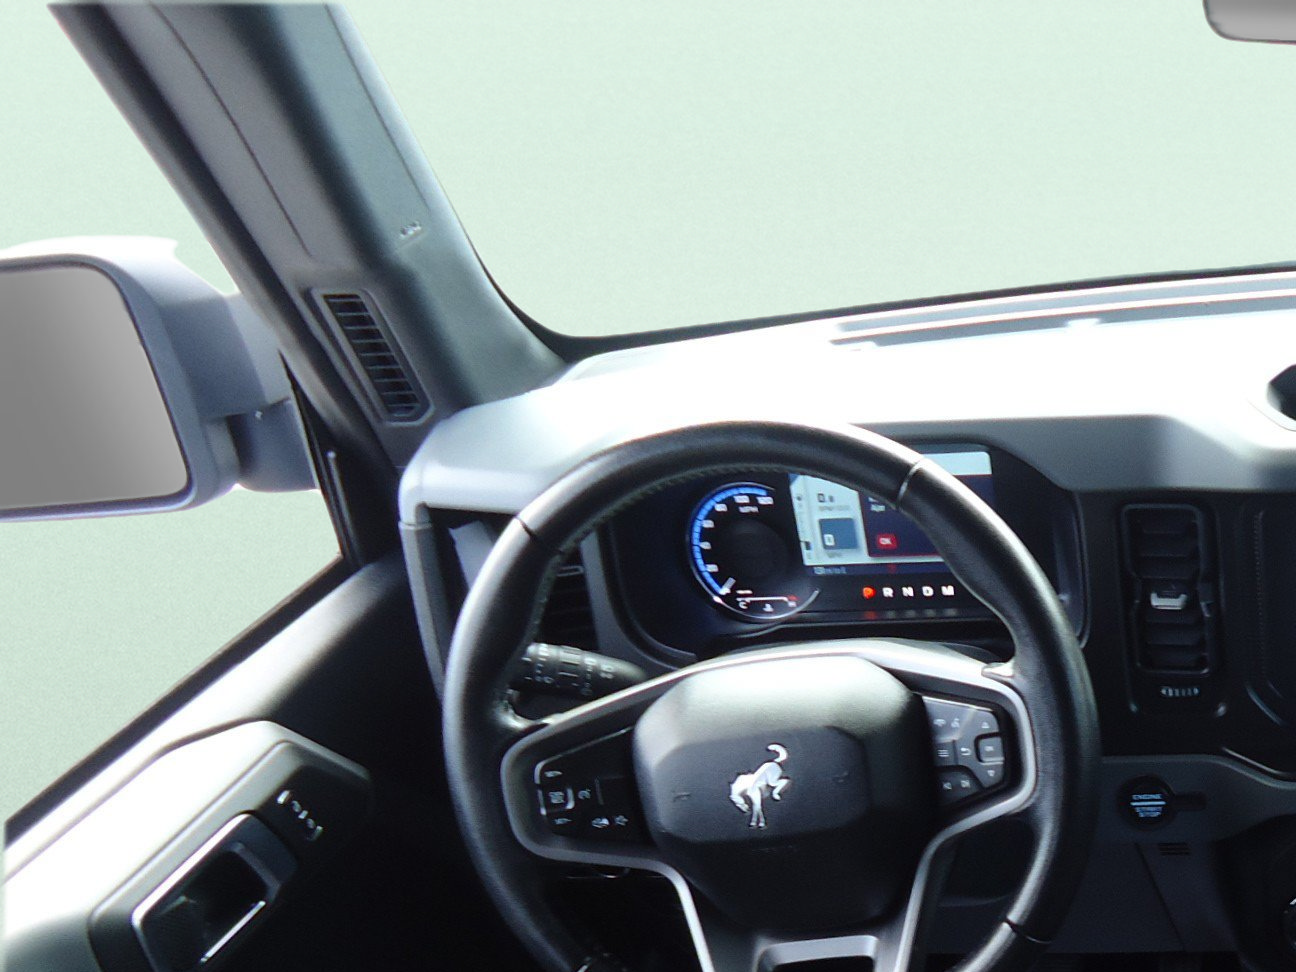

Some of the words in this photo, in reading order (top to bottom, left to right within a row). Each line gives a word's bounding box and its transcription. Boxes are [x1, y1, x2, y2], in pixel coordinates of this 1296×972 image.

[882, 587, 895, 598] R
[901, 586, 914, 597] N
[922, 586, 934, 597] D
